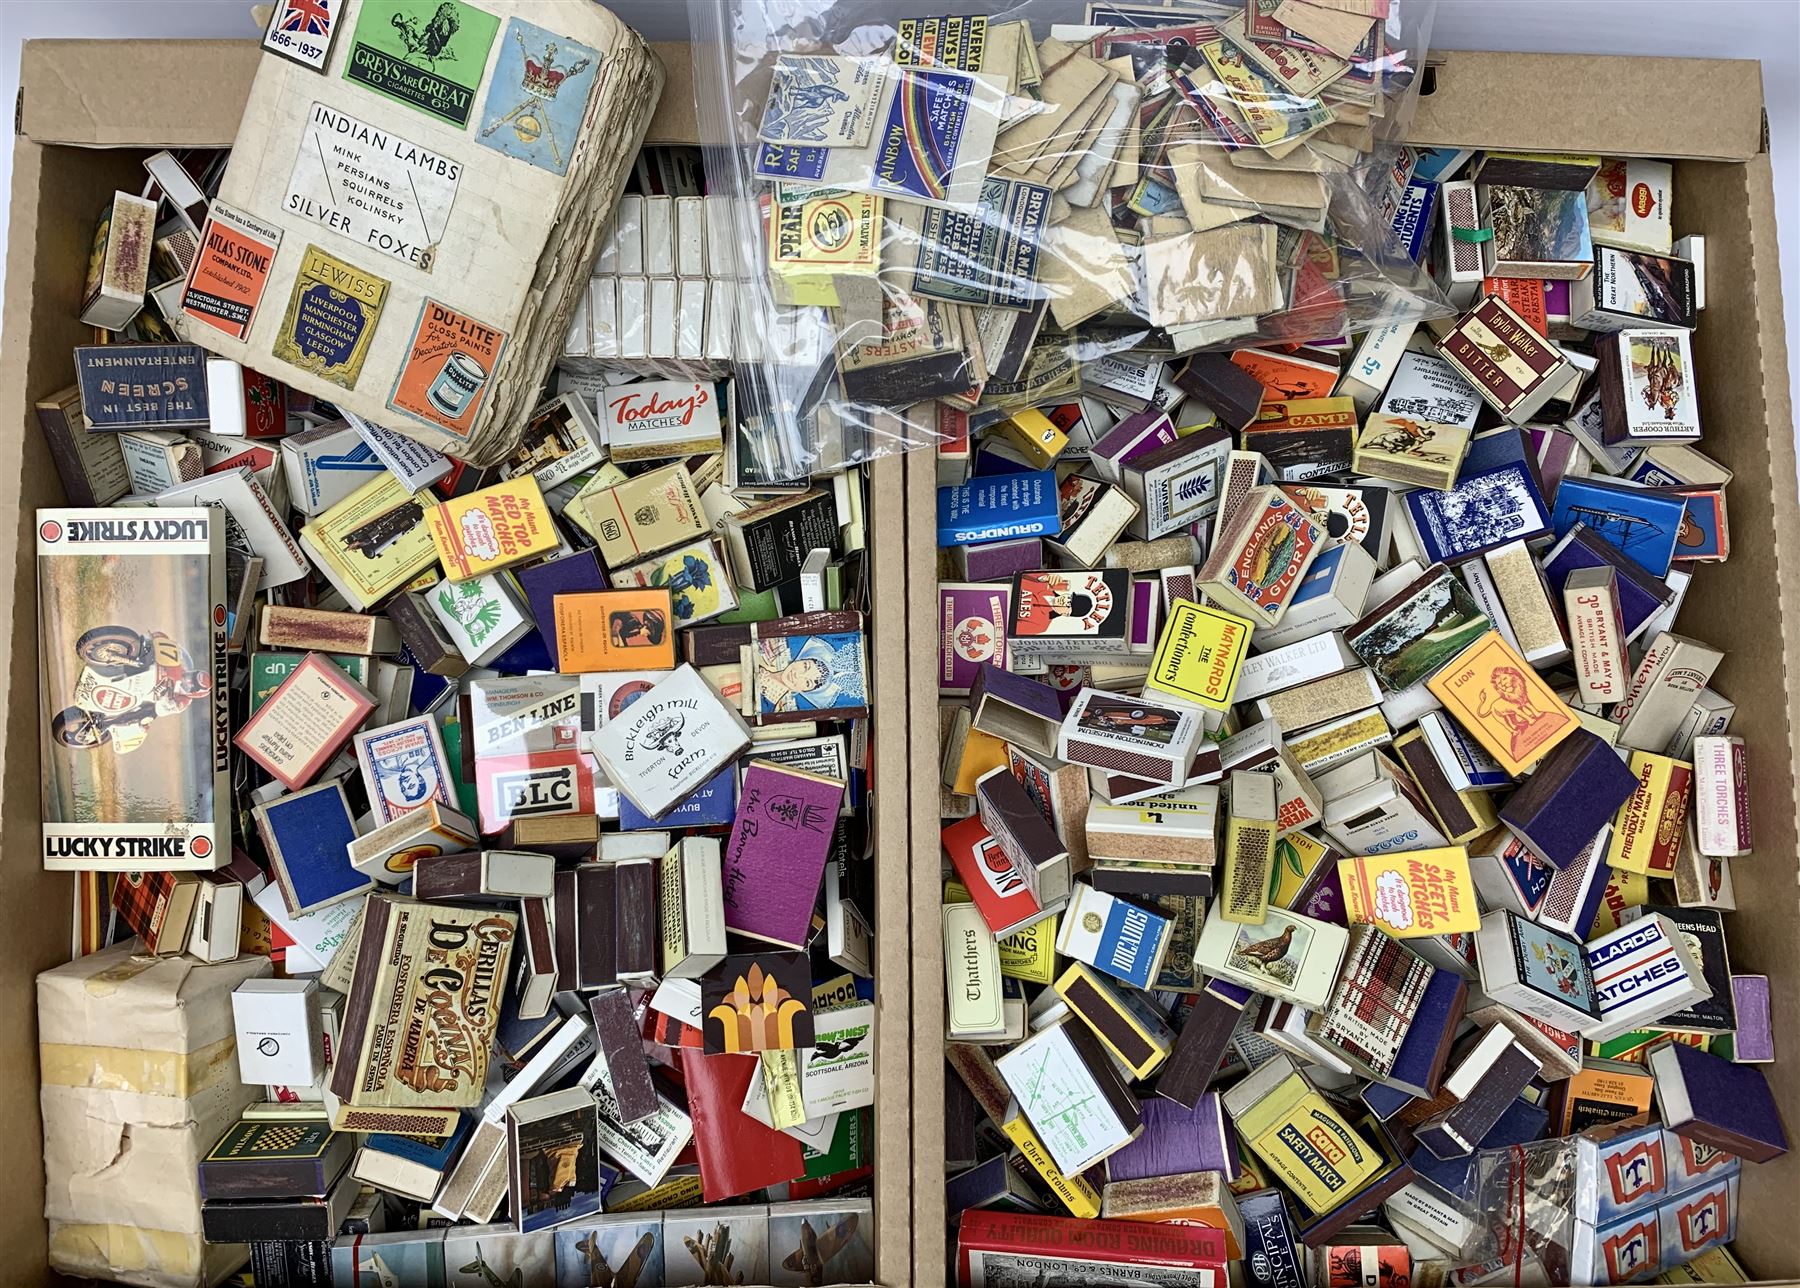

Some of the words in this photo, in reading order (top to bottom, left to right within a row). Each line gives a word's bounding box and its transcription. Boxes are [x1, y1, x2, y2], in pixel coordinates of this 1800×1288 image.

[944, 21, 960, 55] BUYS
[366, 70, 382, 84] 10
[387, 80, 425, 101] CIGARETTES
[401, 72, 419, 88] ARE
[418, 76, 469, 109] GREAT
[930, 82, 948, 123] SAFETY
[937, 79, 957, 131] MATCHES
[315, 108, 388, 151] INDIAN
[394, 142, 459, 180] LAMBS
[943, 110, 958, 147] BRITISH
[333, 145, 361, 162] MINK
[877, 124, 908, 190] RAINBOW
[337, 162, 390, 189] PERSIANS
[342, 179, 404, 210] SQUIRRELS
[347, 196, 404, 224] KOLINSKY
[1637, 186, 1647, 215] Maggi
[289, 195, 351, 233] SILVER
[367, 229, 432, 269] FOXES
[207, 232, 236, 259] ATLAS
[236, 248, 269, 274] STONE
[201, 267, 235, 289] Established
[311, 258, 375, 298] LEWIS'S
[304, 304, 357, 333] MANCHESTER
[310, 294, 357, 322] LIVERPOOL
[302, 314, 354, 343] BIRMINGHAM
[305, 326, 346, 349] GLASGOW
[425, 332, 440, 342] for
[428, 322, 457, 339] GLOSS
[458, 334, 492, 356] PAINTS
[1488, 310, 1513, 335] Taylor
[1509, 329, 1539, 359] Walker
[87, 355, 195, 368] ENTERTAINMENT
[306, 338, 335, 356] LEEDS
[413, 340, 458, 360] Decorators
[1100, 358, 1146, 378] WINES
[1459, 344, 1504, 388] BITTER
[101, 378, 189, 398] SCREEN
[104, 404, 118, 413] IN
[126, 402, 158, 412] BEST
[168, 401, 193, 410] THE
[609, 384, 708, 425] Today's
[1289, 413, 1350, 427] CAMP
[628, 416, 683, 431] MATCHES
[1633, 425, 1664, 433] COOPER
[1668, 425, 1695, 433] ARTHUR
[197, 437, 231, 454] MATCHES
[382, 440, 414, 478] Reservations
[402, 449, 422, 472] London
[520, 498, 530, 510] My
[989, 486, 997, 509] component
[1160, 479, 1170, 522] WINES
[68, 520, 137, 541] STRIKE
[138, 520, 208, 540] LUCKY
[464, 524, 476, 548] matches
[484, 495, 518, 555] MATCHES
[500, 494, 520, 518] RED
[512, 522, 532, 547] TOP
[524, 512, 539, 534] Mums
[955, 522, 1044, 539] GRUNDFOS
[1269, 537, 1306, 597] GLORY
[993, 603, 1003, 632] THREE
[1019, 591, 1031, 619] ALES
[1082, 575, 1111, 631] TETLEY
[1016, 639, 1064, 647] JOSHUA
[1066, 639, 1107, 647] TETLEY
[1165, 612, 1198, 683] confectioners
[1587, 619, 1596, 650] BRITISH
[1596, 609, 1608, 650] BRYANT
[1602, 659, 1612, 681] MAY
[216, 631, 227, 708] STRIKE
[1200, 646, 1212, 664] THE
[1206, 624, 1238, 697] MAYNARDS
[1264, 646, 1308, 670] WALKER
[1304, 640, 1327, 658] LTD
[1591, 652, 1600, 674] MADE
[1656, 645, 1672, 667] MATCH
[1454, 670, 1475, 688] LION
[1616, 648, 1657, 725] Souvenir
[488, 718, 528, 744] BEN
[530, 693, 576, 724] LINE
[216, 709, 229, 772] LUCKY
[639, 756, 666, 779] TIVERTON
[691, 721, 711, 738] DEVON
[1077, 727, 1106, 740] MUSEUM
[1108, 731, 1165, 749] DONINGTON
[1713, 743, 1725, 774] THREE
[507, 779, 572, 807] BLC
[1148, 801, 1198, 810] united
[1715, 779, 1729, 826] TORCHES
[1620, 813, 1640, 860] FRIENDLY
[1632, 762, 1653, 814] MATCHES
[46, 838, 112, 857] LUCKY
[116, 838, 185, 857] STRIKE
[737, 819, 758, 863] Baron
[837, 847, 846, 878] Hotels
[724, 864, 746, 908] Hotel
[1407, 860, 1434, 930] MATCHES
[1424, 864, 1450, 922] SAFETY
[1449, 883, 1462, 913] Mums
[1110, 909, 1149, 974] DUCADOS
[1696, 923, 1718, 933] HEAD
[389, 923, 408, 967] SEGURIDAD
[468, 914, 515, 1023] CERILLAS
[967, 929, 981, 1002] Thatchers
[390, 955, 412, 1027] FOSFORERA
[421, 964, 474, 1067] COCINA
[1344, 1012, 1368, 1033] BRITISH
[1372, 1033, 1388, 1046] MADE
[1702, 1014, 1724, 1022] MALTON
[374, 1024, 384, 1049] MADE
[402, 1021, 424, 1072] MADERA
[1335, 1022, 1365, 1046] BRYANT
[1370, 1046, 1386, 1059] MAY
[1359, 1030, 1369, 1040] BY
[376, 1029, 396, 1092] ESPAÑOLA
[805, 1065, 844, 1078] SCOTTSDALE,
[844, 1059, 869, 1069] ARIZONA
[364, 1064, 376, 1092] SPAIN
[229, 1123, 261, 1157] WILSONS
[848, 1115, 857, 1161] BAKERS
[1311, 1128, 1344, 1163] cara
[1312, 1110, 1337, 1130] MAGUIRE
[1339, 1130, 1362, 1162] PATERSON'S
[1022, 1140, 1046, 1167] Three
[1046, 1168, 1076, 1204] Crowns
[1270, 1152, 1287, 1172] AVERAGE
[1286, 1169, 1308, 1191] CONTENTS
[1281, 1127, 1314, 1160] SAFETY
[1308, 1157, 1343, 1191] MATCH
[1414, 1204, 1432, 1217] GREAT
[1430, 1213, 1448, 1227] BRITAIN
[1423, 1203, 1443, 1218] BRYANT
[987, 1228, 1063, 1246] QUALITY
[1068, 1231, 1122, 1249] ROOM
[1127, 1238, 1216, 1258] DRAWING
[1016, 1259, 1068, 1273] LONDON
[1100, 1267, 1141, 1280] BARNES
